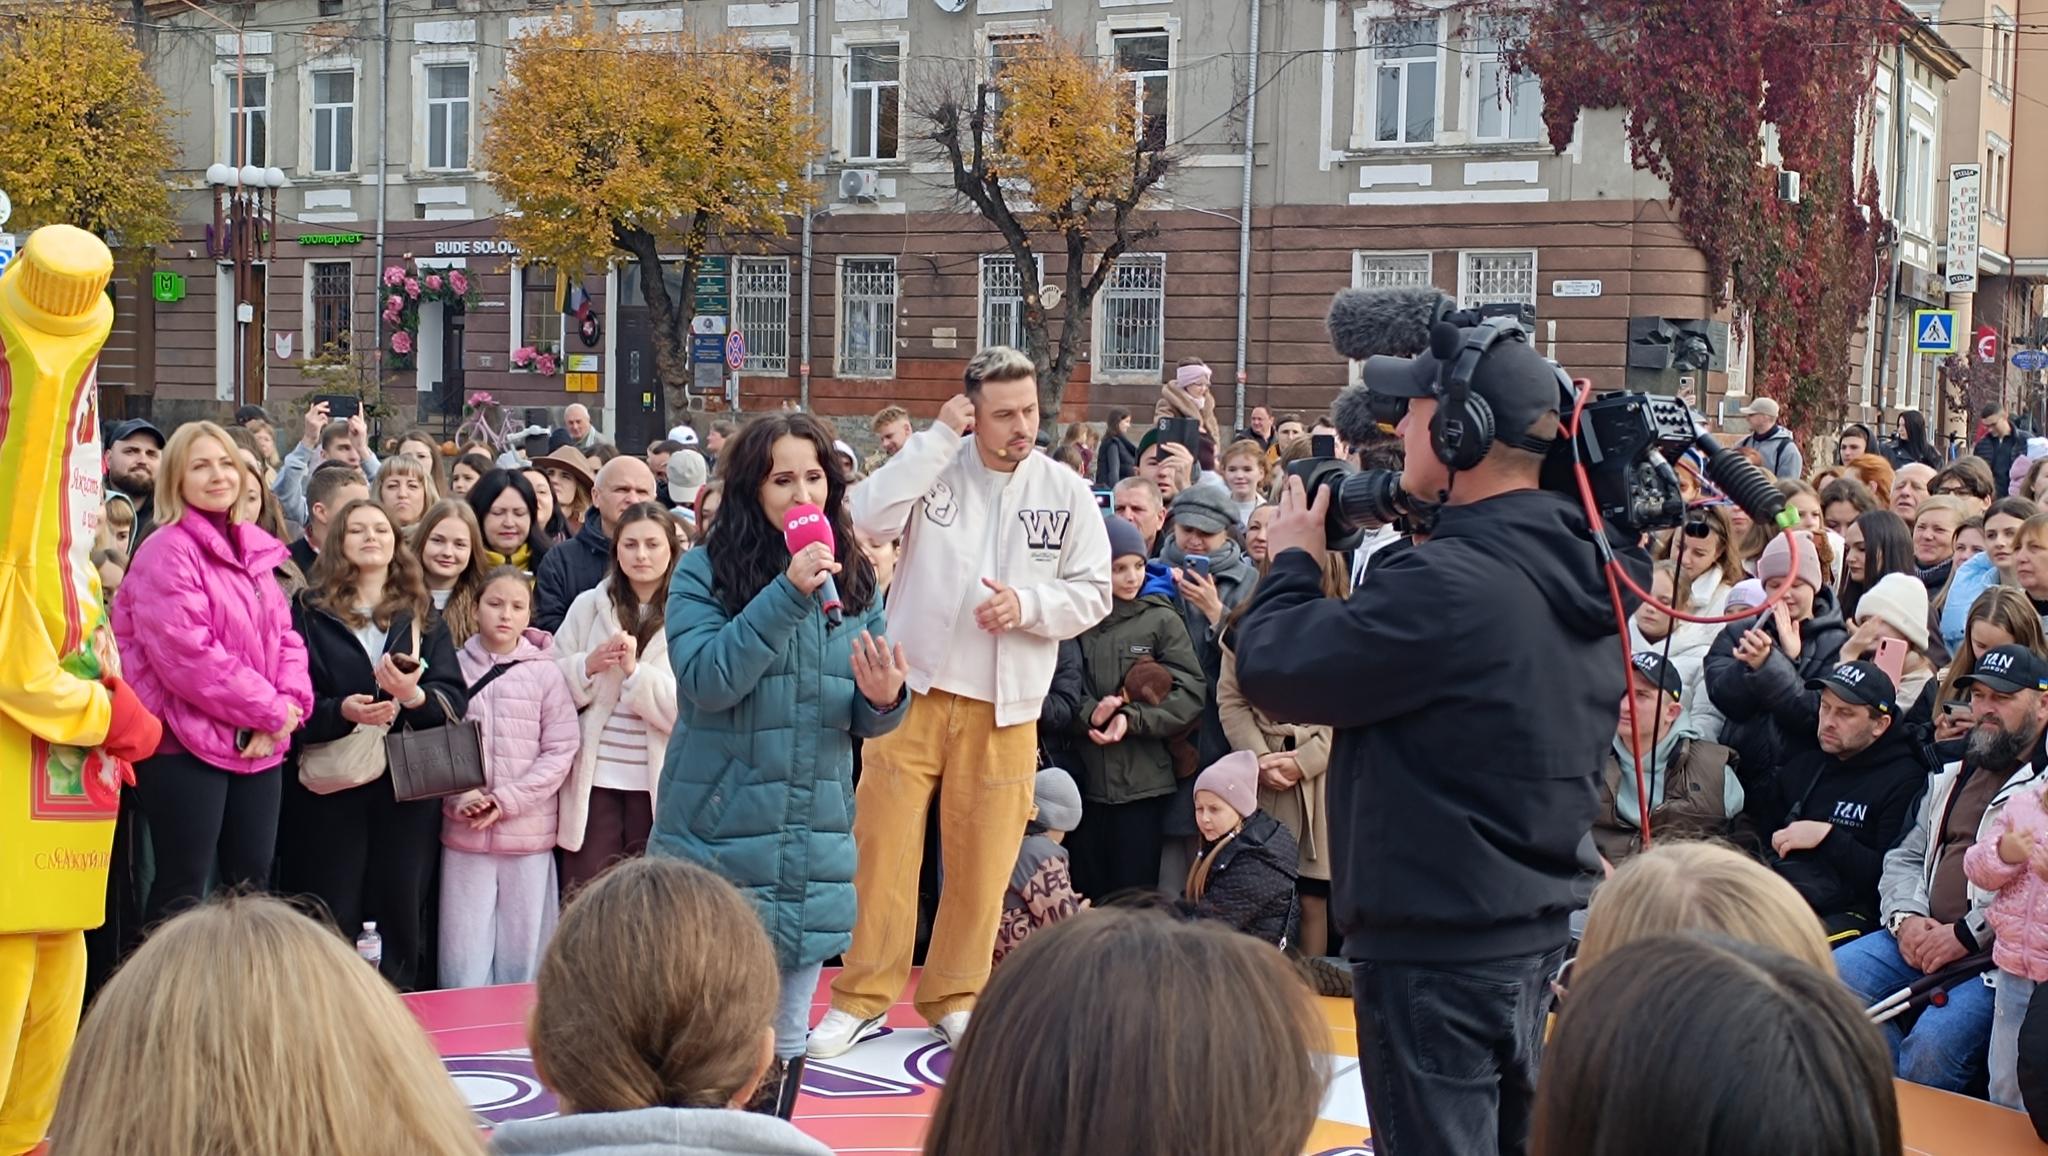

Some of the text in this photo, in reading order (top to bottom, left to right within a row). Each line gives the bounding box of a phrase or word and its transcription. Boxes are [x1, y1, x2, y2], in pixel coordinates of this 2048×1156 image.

[435, 241, 469, 254] BUDE
[1590, 282, 1600, 294] 21
[1018, 510, 1070, 550] W
